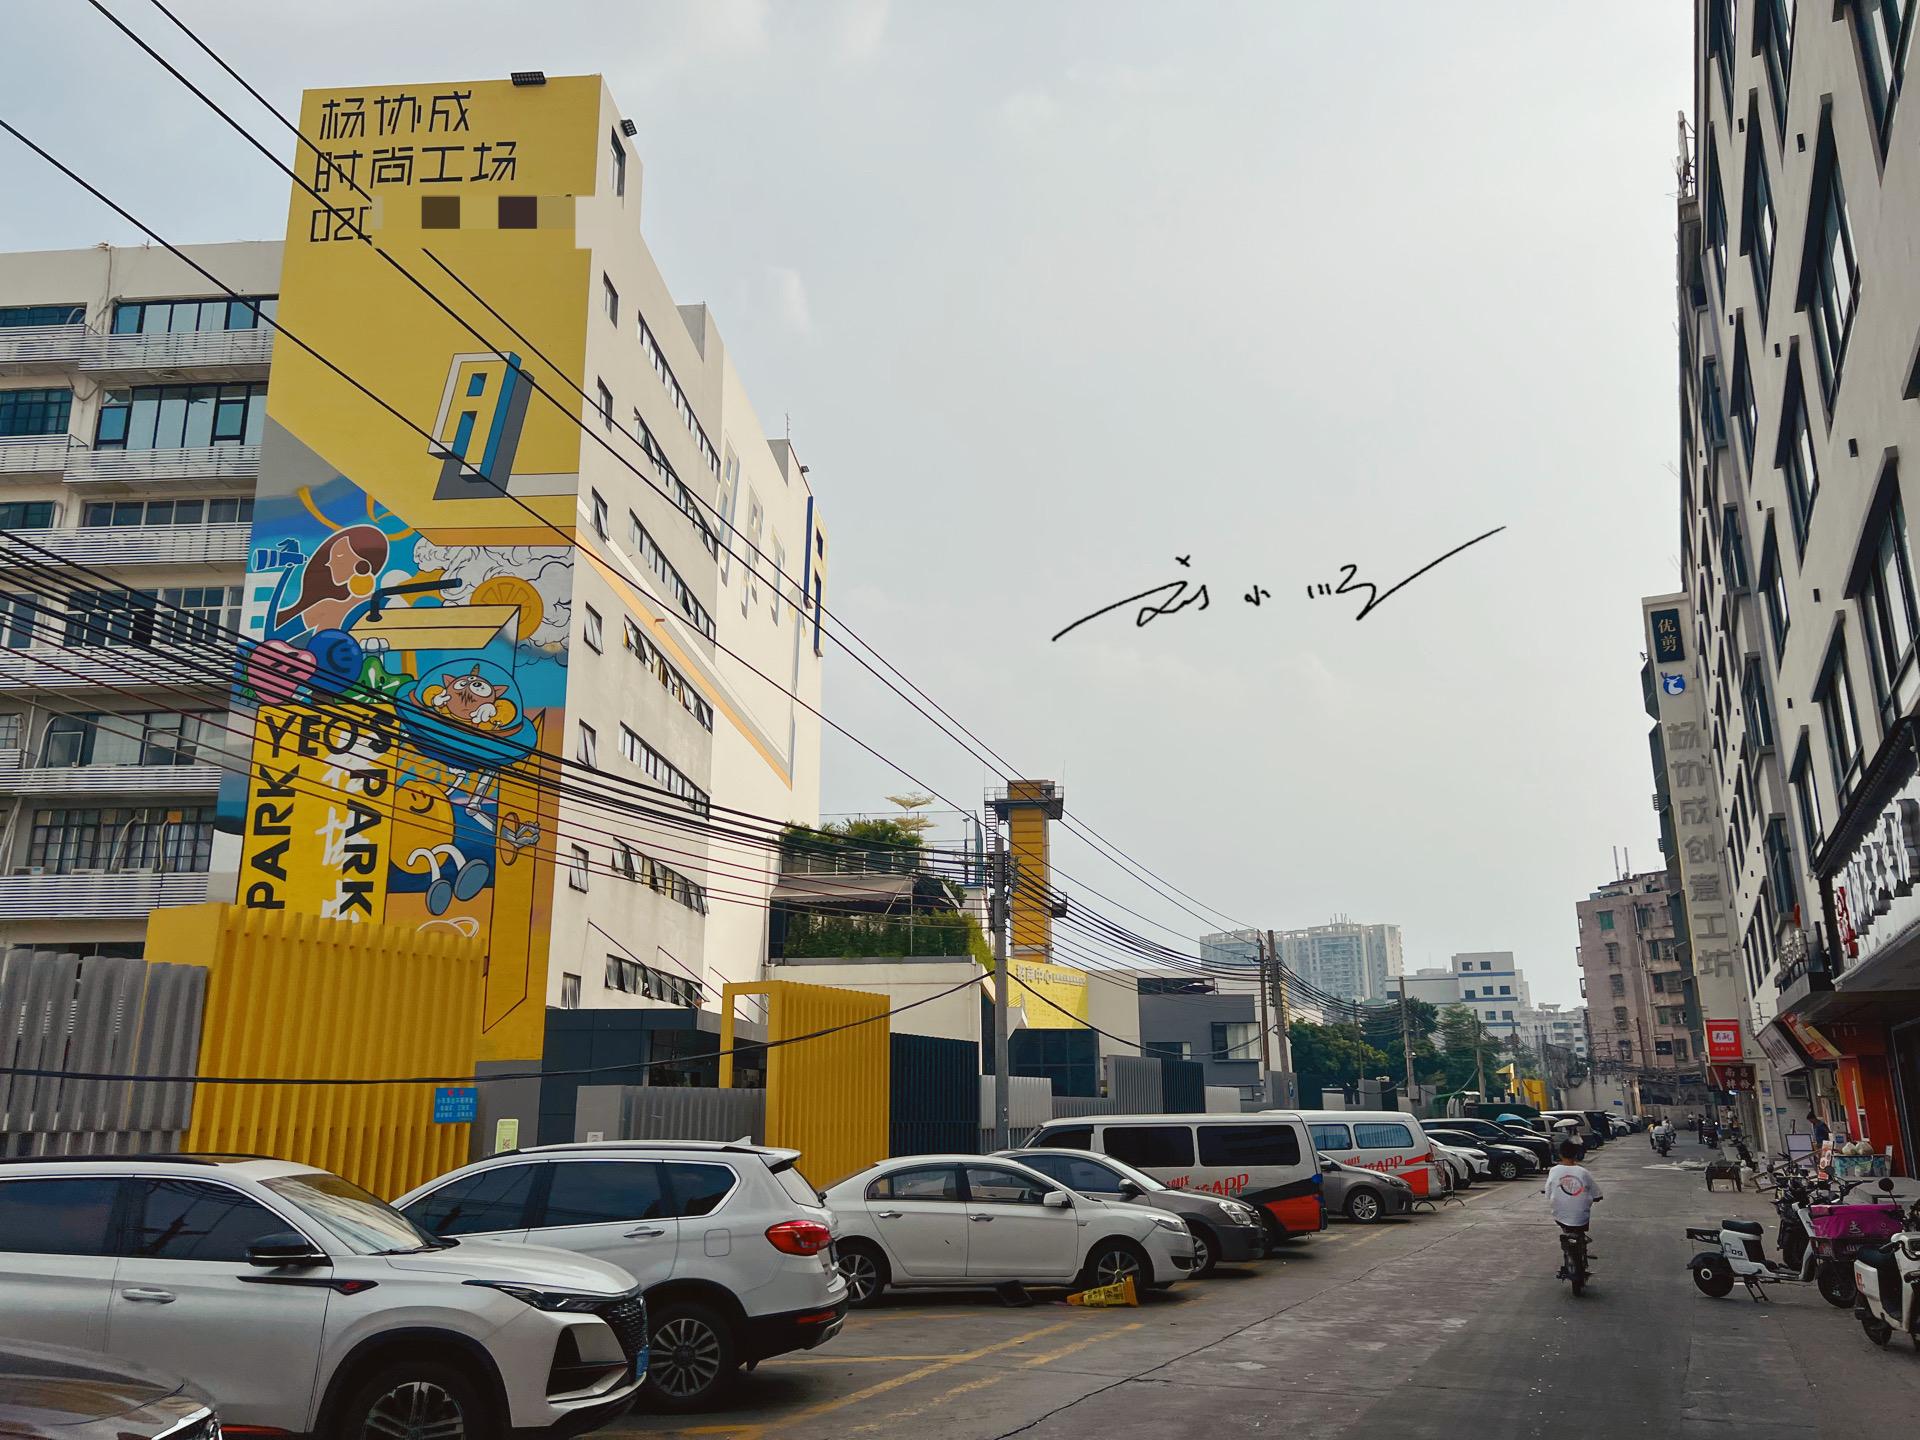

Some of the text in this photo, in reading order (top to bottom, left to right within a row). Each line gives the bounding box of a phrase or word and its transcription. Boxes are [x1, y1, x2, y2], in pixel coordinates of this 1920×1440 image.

[313, 141, 517, 193] 时尚工场
[319, 90, 472, 140] 杨协成
[246, 764, 301, 911] PARK
[339, 768, 389, 917] PARK
[1666, 720, 1734, 978] 杨协成创意工坊
